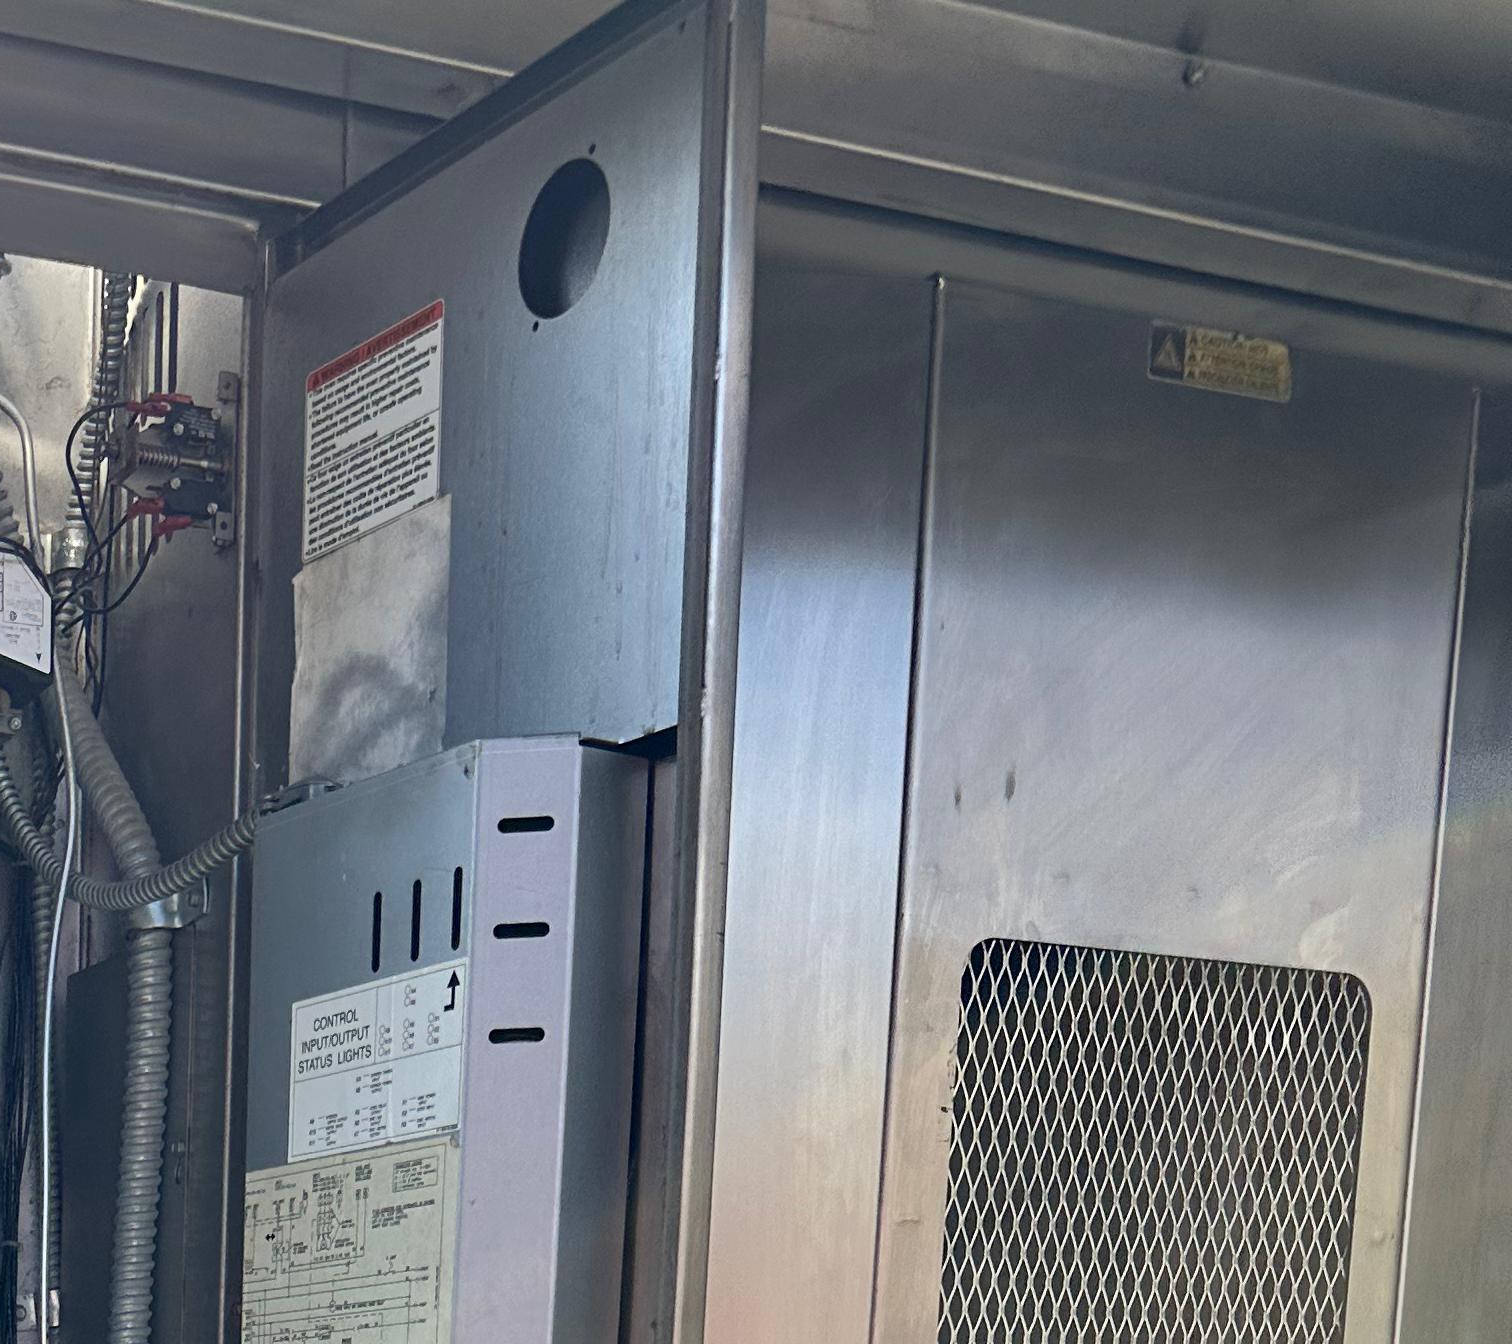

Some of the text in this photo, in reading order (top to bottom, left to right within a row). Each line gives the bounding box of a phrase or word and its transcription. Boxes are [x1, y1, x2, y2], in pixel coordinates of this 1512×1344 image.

[313, 1008, 358, 1032] CONTROL
[301, 1025, 369, 1054] INPUT/OUTPUT
[297, 1044, 371, 1074] STATUS LIGHTS
